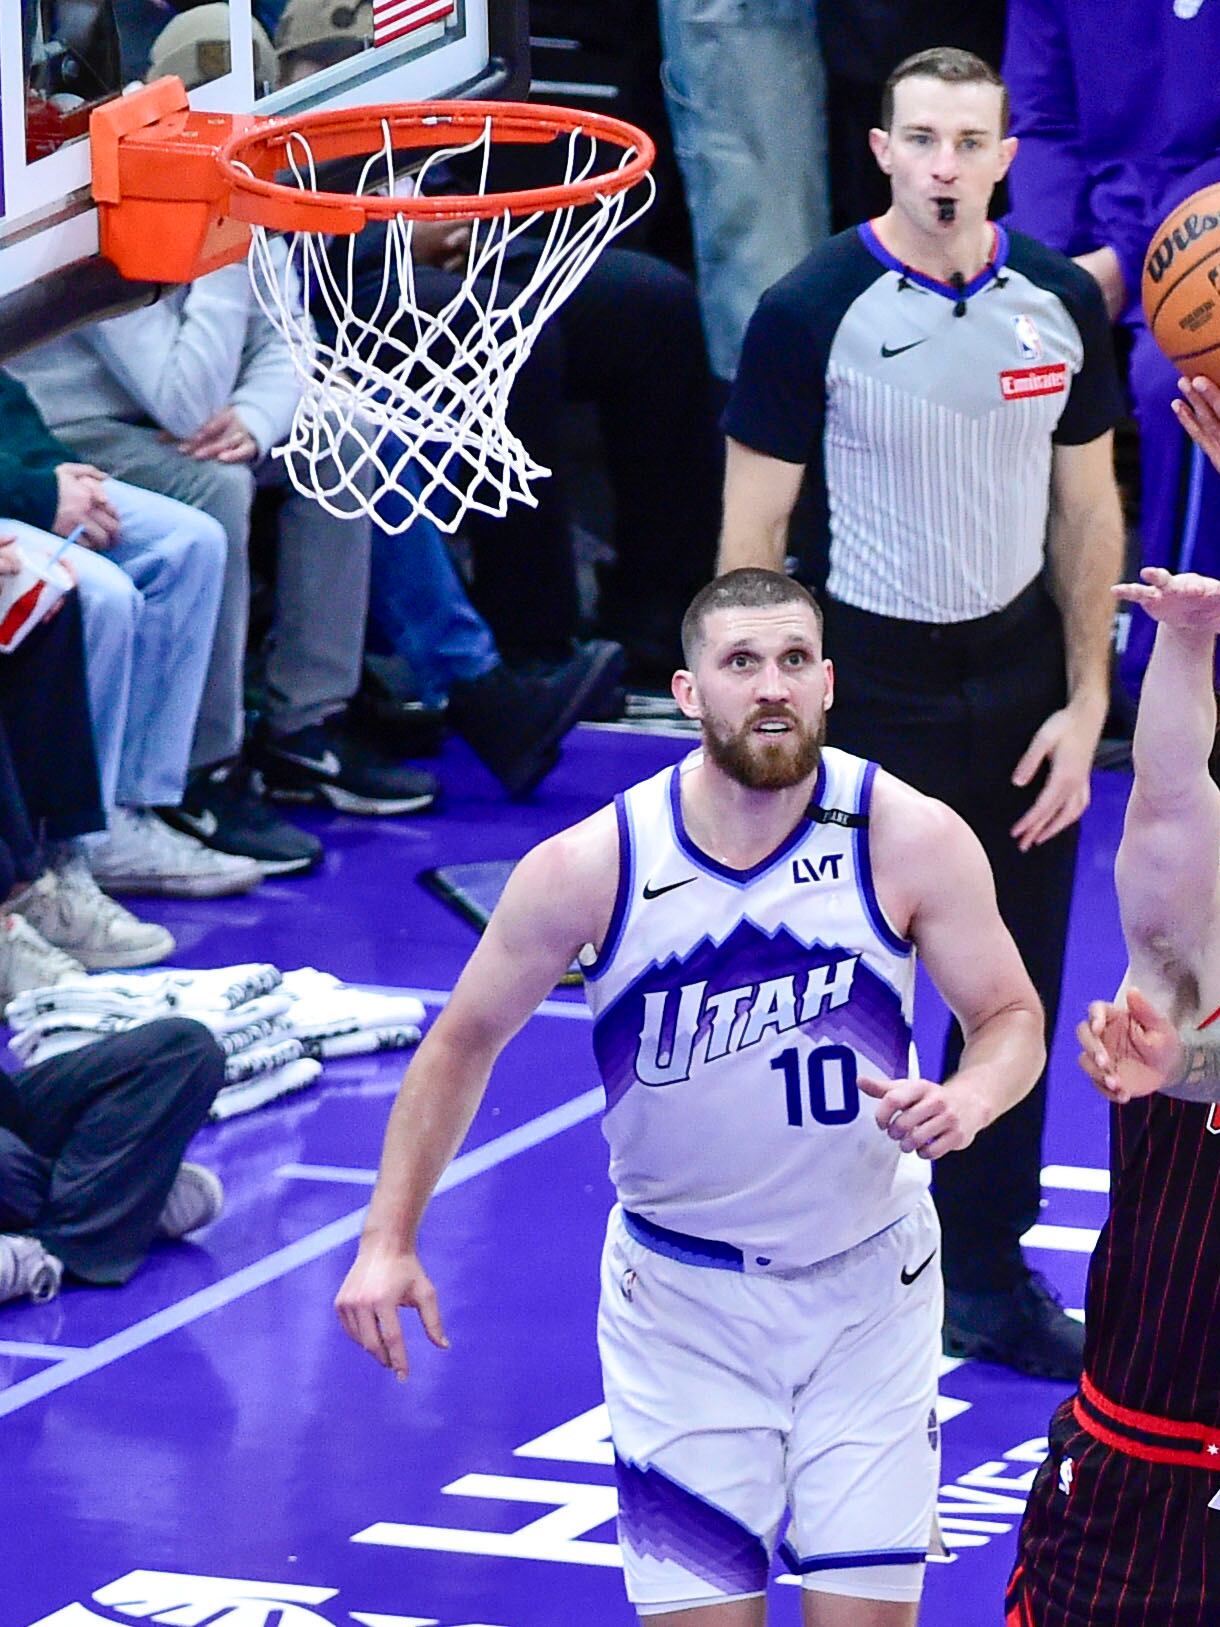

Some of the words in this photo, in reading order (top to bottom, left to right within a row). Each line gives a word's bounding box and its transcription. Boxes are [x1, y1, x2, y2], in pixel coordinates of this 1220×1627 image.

[793, 854, 843, 884] LVT
[634, 952, 862, 1087] UTAH
[770, 1045, 860, 1127] 10
